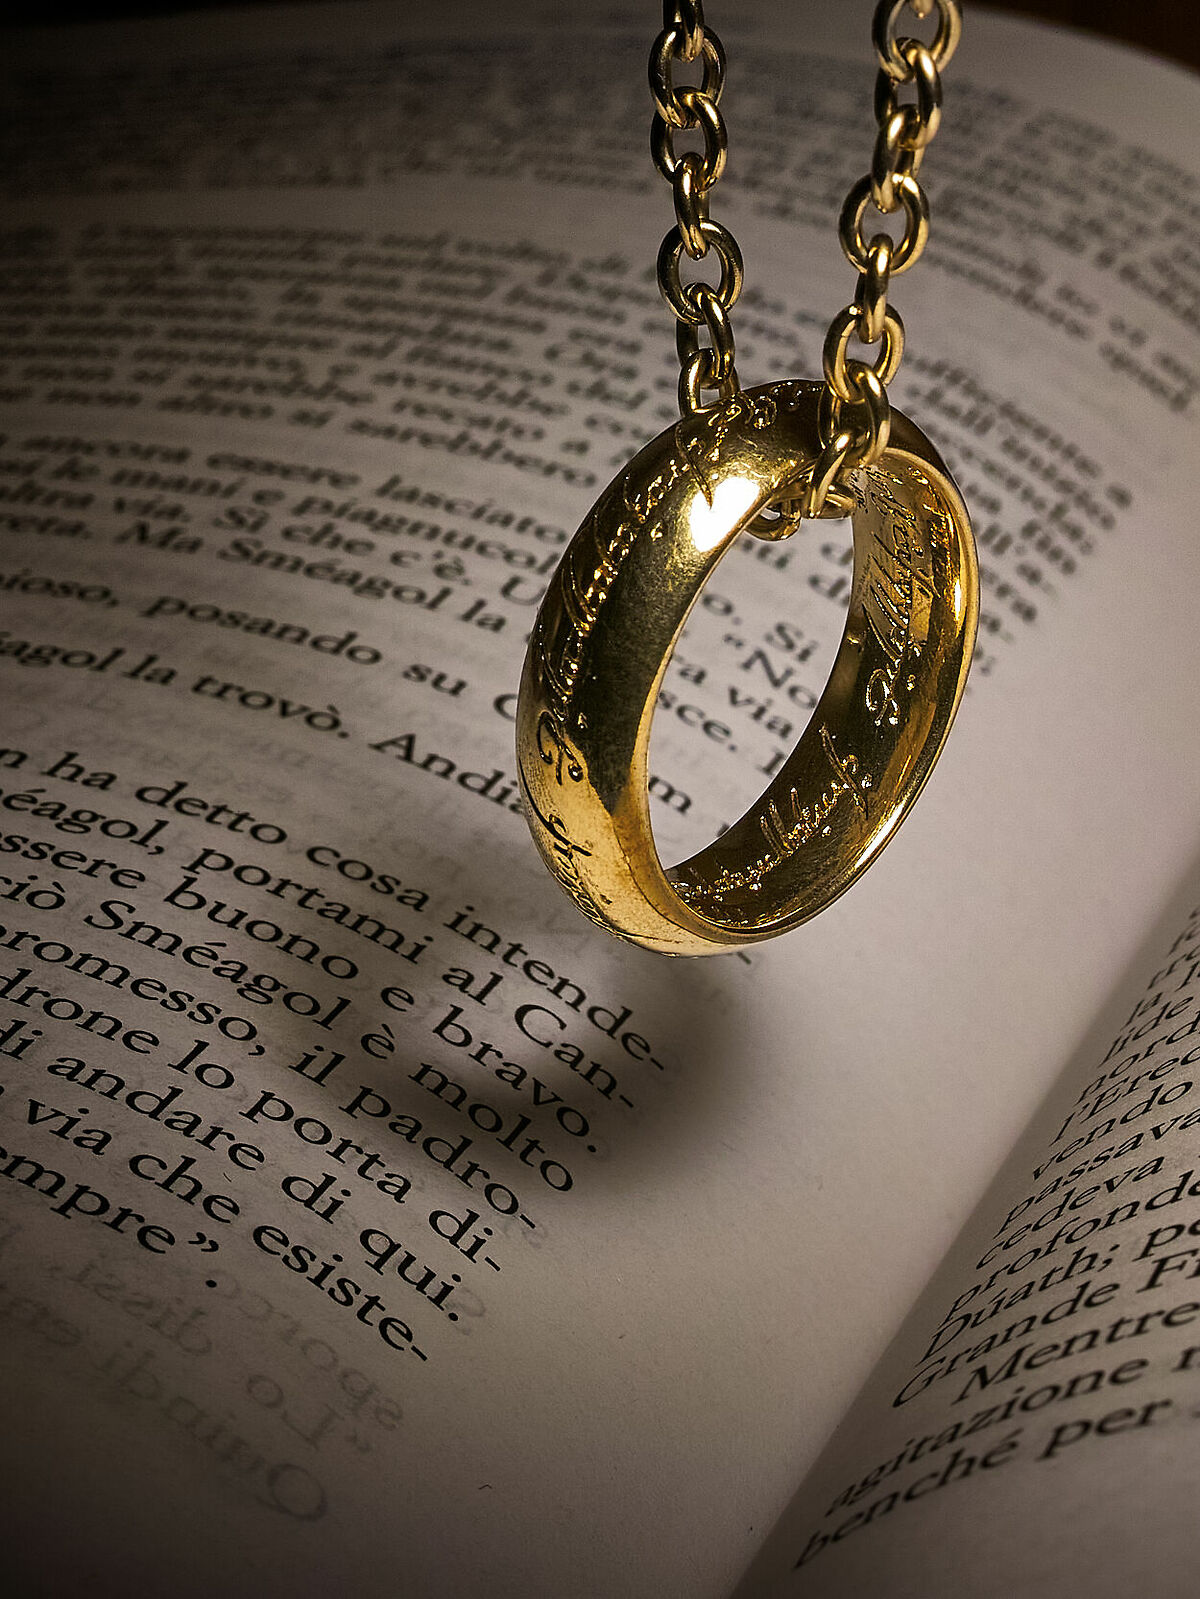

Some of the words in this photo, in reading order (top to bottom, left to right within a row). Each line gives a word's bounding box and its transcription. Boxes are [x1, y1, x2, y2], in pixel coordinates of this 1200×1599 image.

[122, 654, 177, 686] la
[191, 676, 350, 739] trovò.
[140, 596, 382, 665] posando
[402, 664, 467, 697] su
[40, 752, 117, 791] ha
[136, 781, 287, 848] detto
[306, 846, 429, 912] cosa
[442, 905, 664, 1072] intende-
[181, 846, 434, 968] portami
[441, 968, 503, 1006] al
[515, 1004, 634, 1109] Can-
[85, 900, 350, 1031] Sméagol
[361, 1024, 395, 1059] è
[407, 1062, 573, 1191] molto
[163, 876, 359, 983] buono
[380, 987, 414, 1012] e
[432, 1004, 597, 1153] bravo.
[47, 1058, 264, 1171] andare
[281, 1173, 351, 1224] di
[357, 1229, 461, 1326] qui.
[167, 1040, 234, 1089] lo
[239, 1085, 413, 1203] porta
[429, 1209, 500, 1271] di-
[288, 1045, 346, 1088] il
[338, 1085, 536, 1229] padro-
[976, 1155, 1165, 1275] cedeva
[1032, 1080, 1193, 1184] vendo
[27, 1099, 112, 1155] via
[128, 1155, 240, 1223] che
[253, 1226, 428, 1361] esiste-
[824, 1355, 1149, 1518] agitazione
[892, 1280, 1122, 1412] Grande
[791, 1422, 1022, 1572] benché
[1036, 1399, 1172, 1461] per
